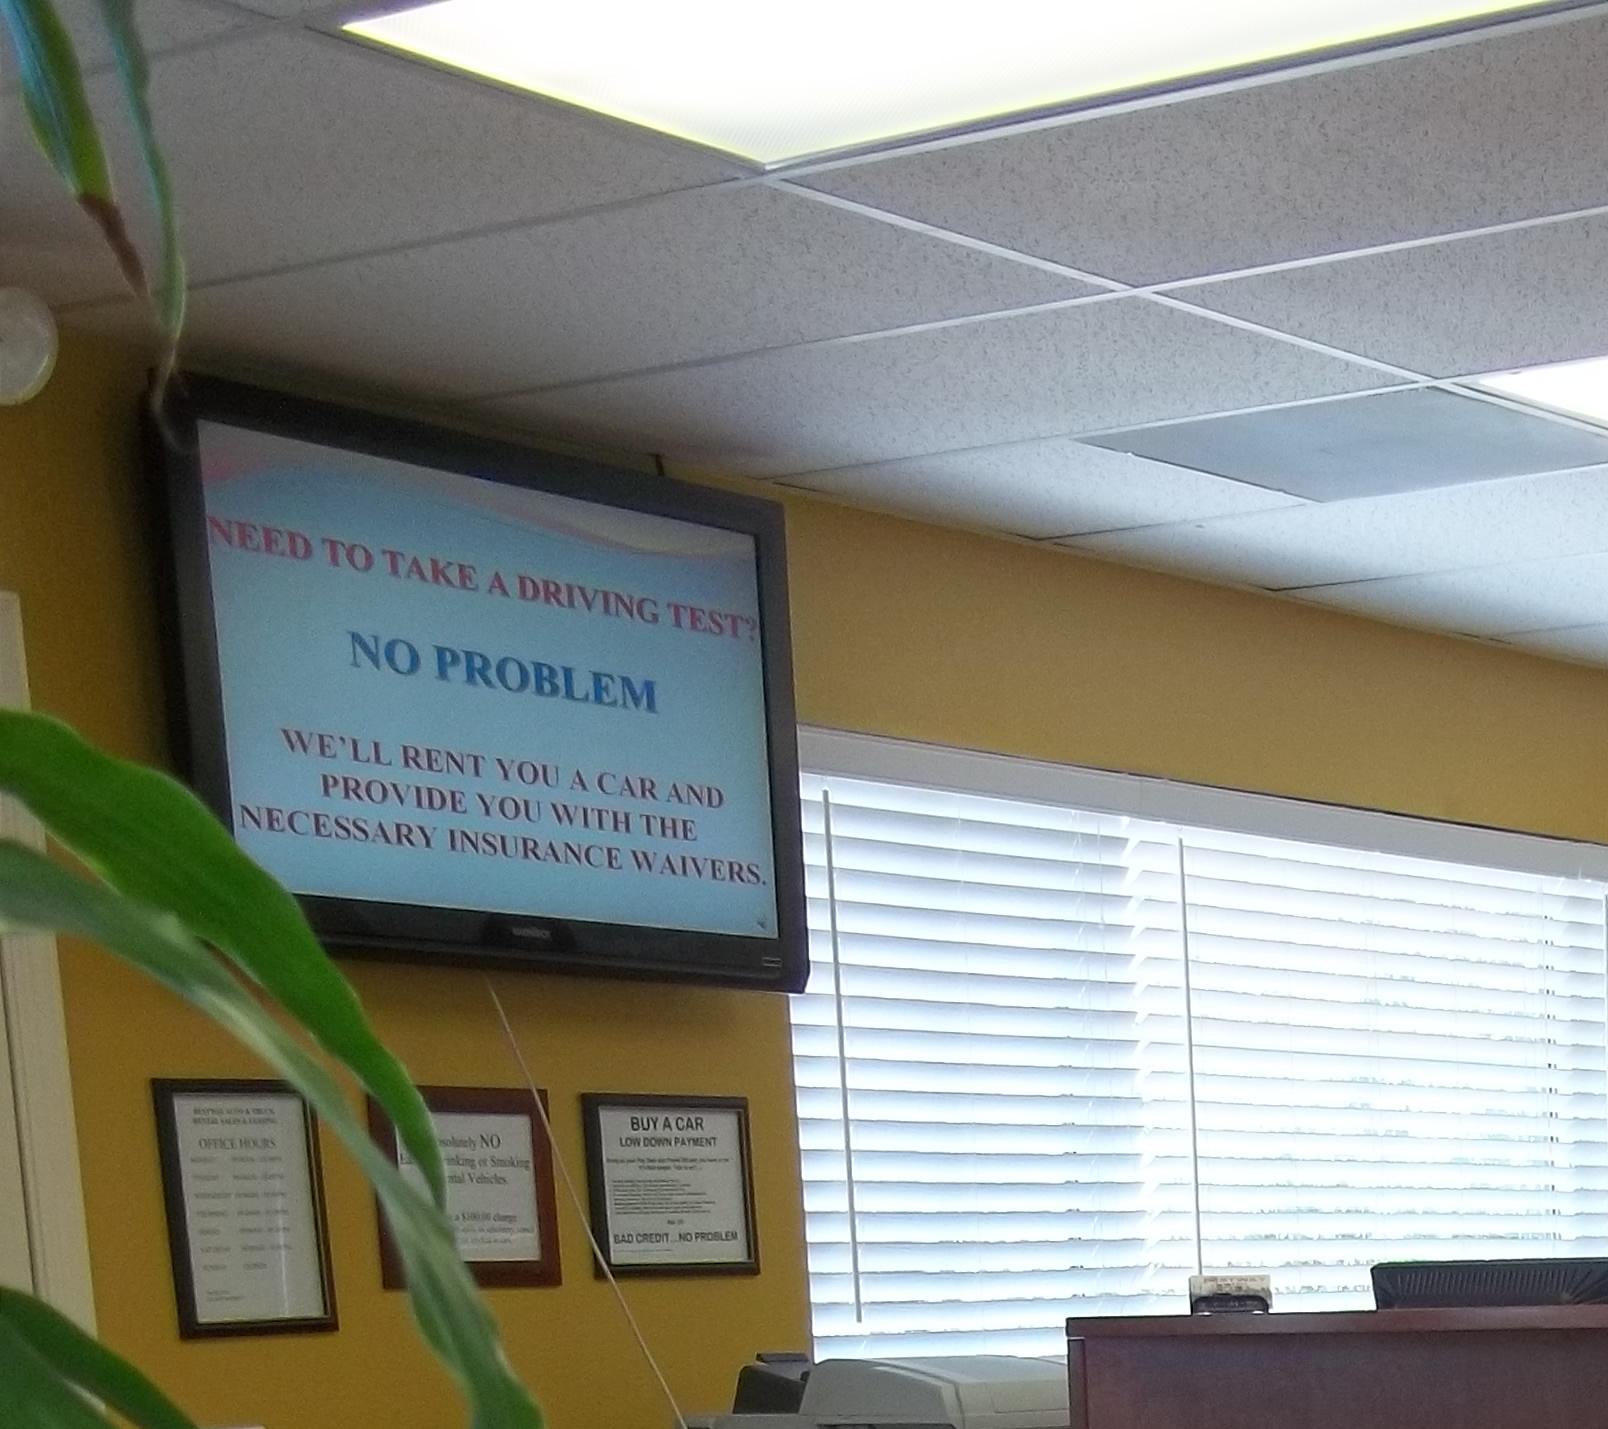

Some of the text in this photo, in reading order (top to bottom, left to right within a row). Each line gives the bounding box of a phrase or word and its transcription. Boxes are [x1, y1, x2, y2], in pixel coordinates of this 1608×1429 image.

[207, 514, 758, 641] NEED TO TAKE A DRIVING TEST?
[347, 630, 659, 715] NO PROBLEM
[402, 743, 486, 778] RENT
[496, 757, 560, 788] YOU
[570, 768, 590, 793] A
[597, 771, 659, 801] CAR
[667, 782, 725, 809] AND
[320, 772, 698, 842] PROVIDE YOU WITH THE
[239, 803, 767, 886] NECESSARY INSURANCE WAIVERS.
[198, 1136, 277, 1150] OFFICE HOURS
[479, 1133, 501, 1149] NO
[619, 1136, 718, 1148] LOW DOWN PAYMENT
[630, 1116, 705, 1132] BUY A CAR
[613, 1232, 634, 1245] BAD
[695, 1230, 738, 1242] PROBLEM
